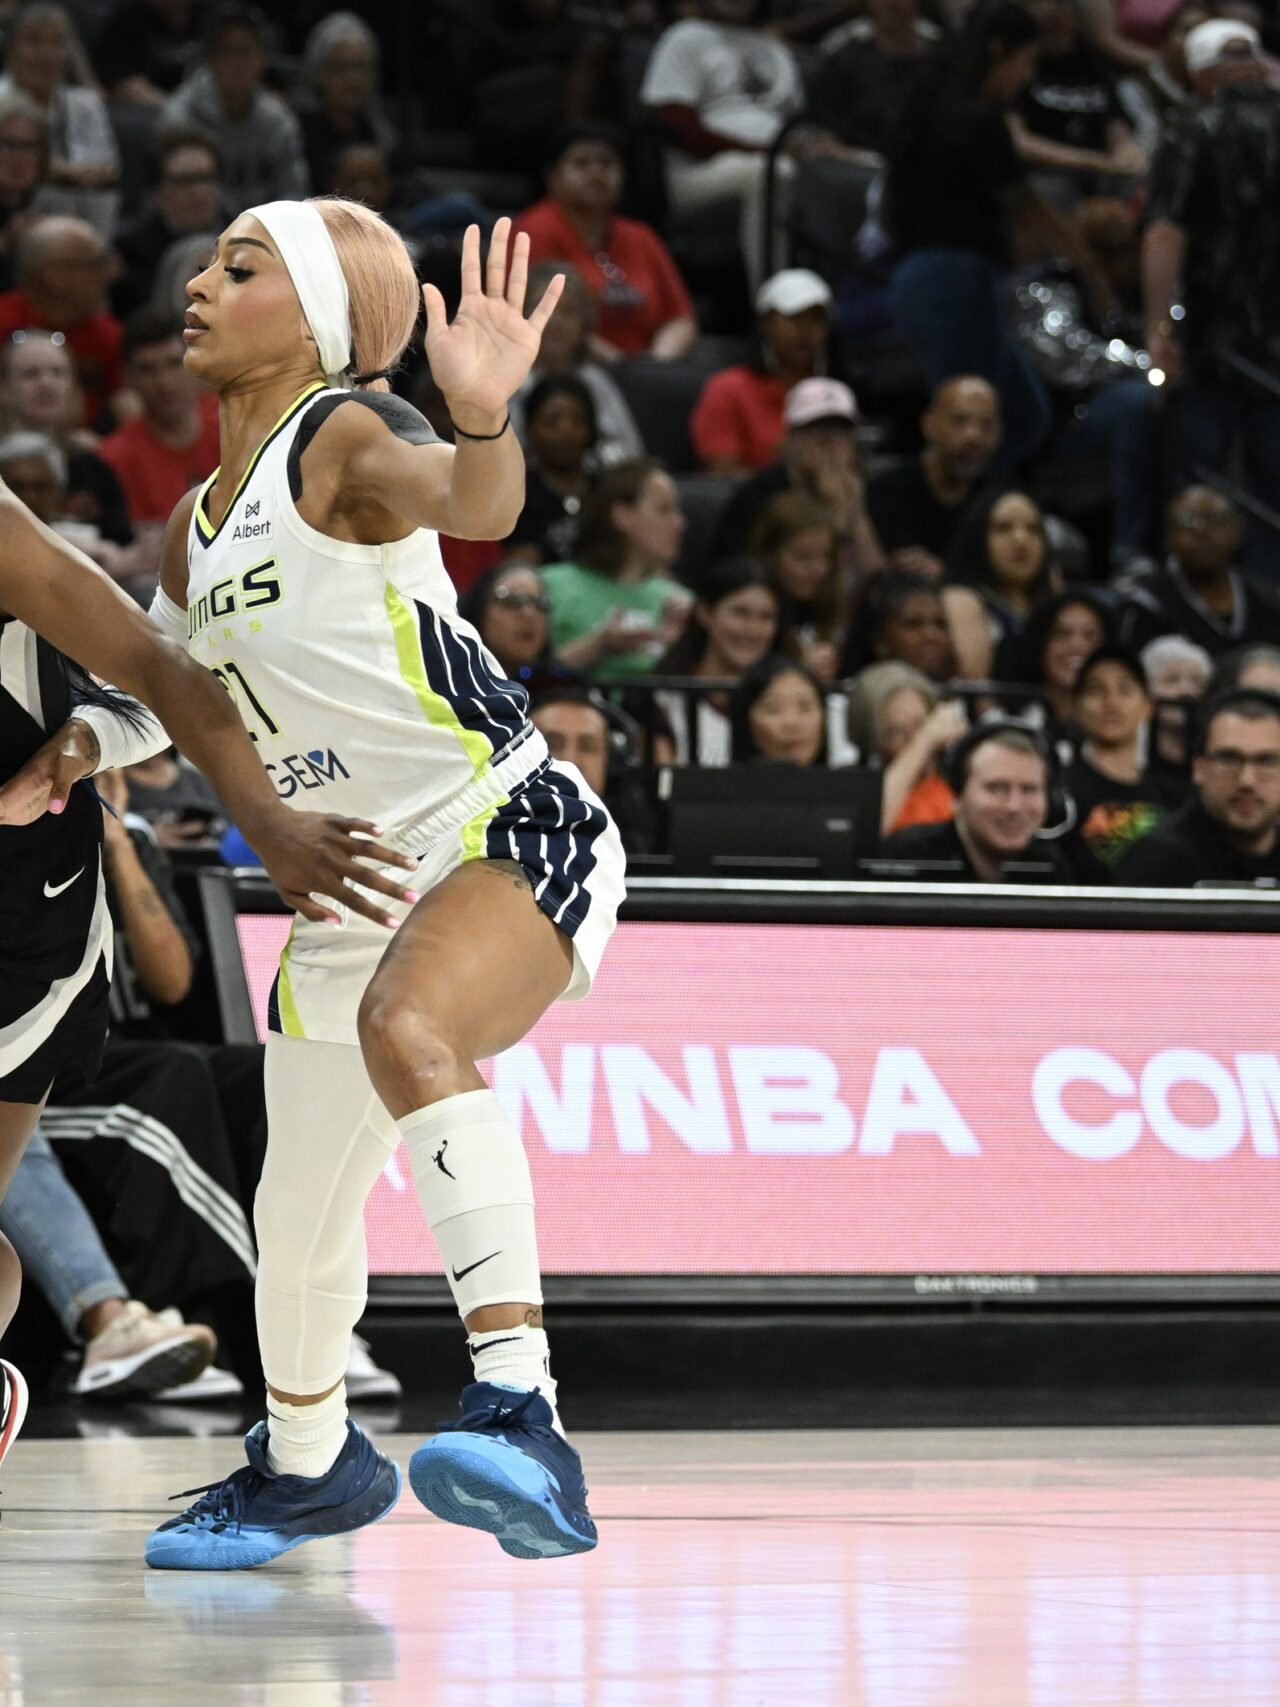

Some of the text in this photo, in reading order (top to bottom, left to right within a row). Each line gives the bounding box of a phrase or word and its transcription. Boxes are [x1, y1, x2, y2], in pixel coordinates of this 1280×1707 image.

[232, 520, 271, 541] Albert
[188, 554, 285, 643] INGS
[492, 1043, 983, 1156] WNBA
